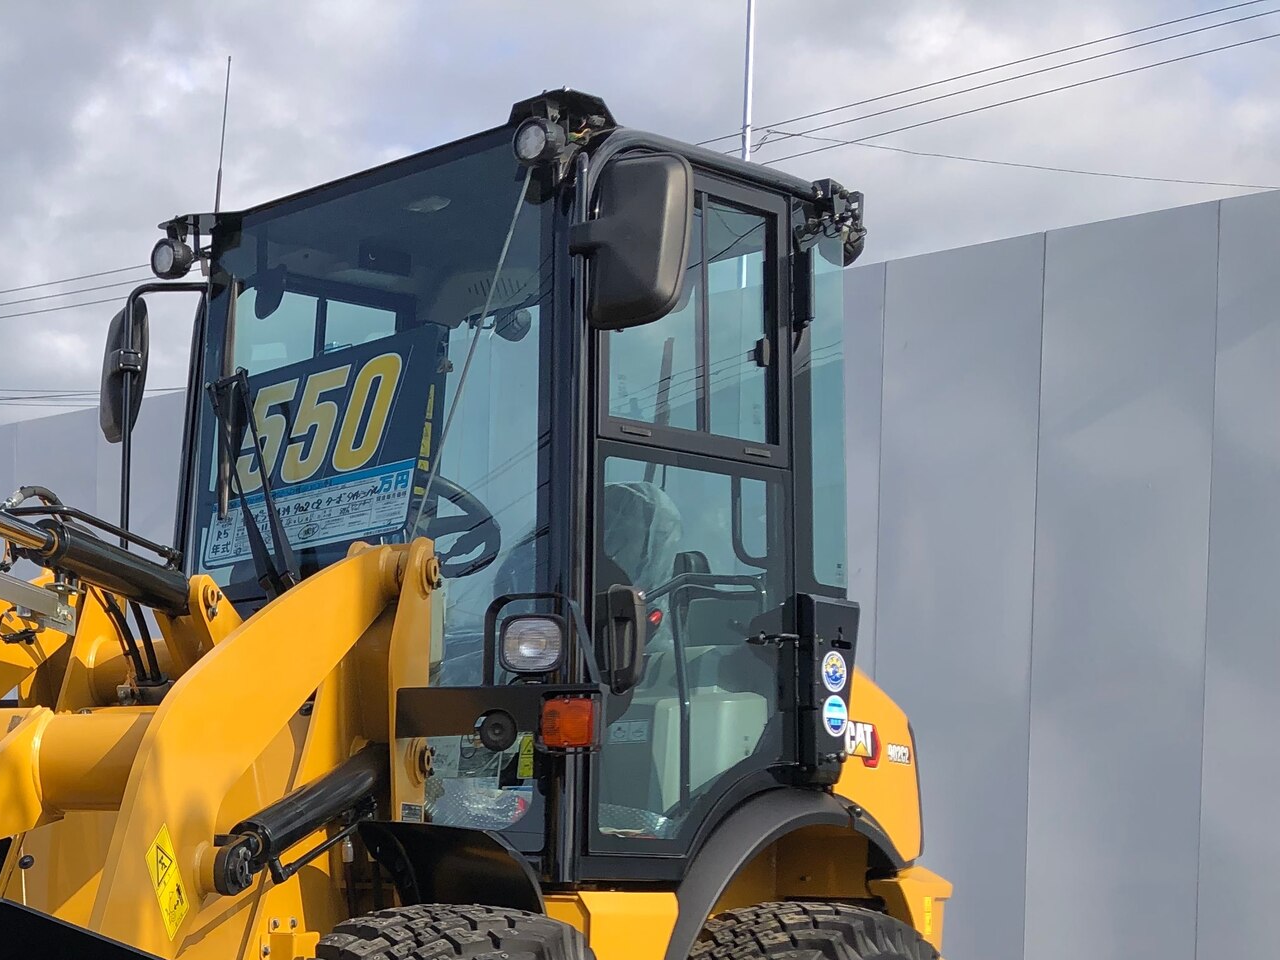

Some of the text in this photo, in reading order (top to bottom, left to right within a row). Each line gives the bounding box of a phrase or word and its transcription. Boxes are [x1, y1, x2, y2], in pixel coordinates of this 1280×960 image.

[232, 352, 403, 495] 550
[377, 470, 410, 494] 万円
[210, 541, 231, 556] 年式
[845, 720, 874, 758] CAT
